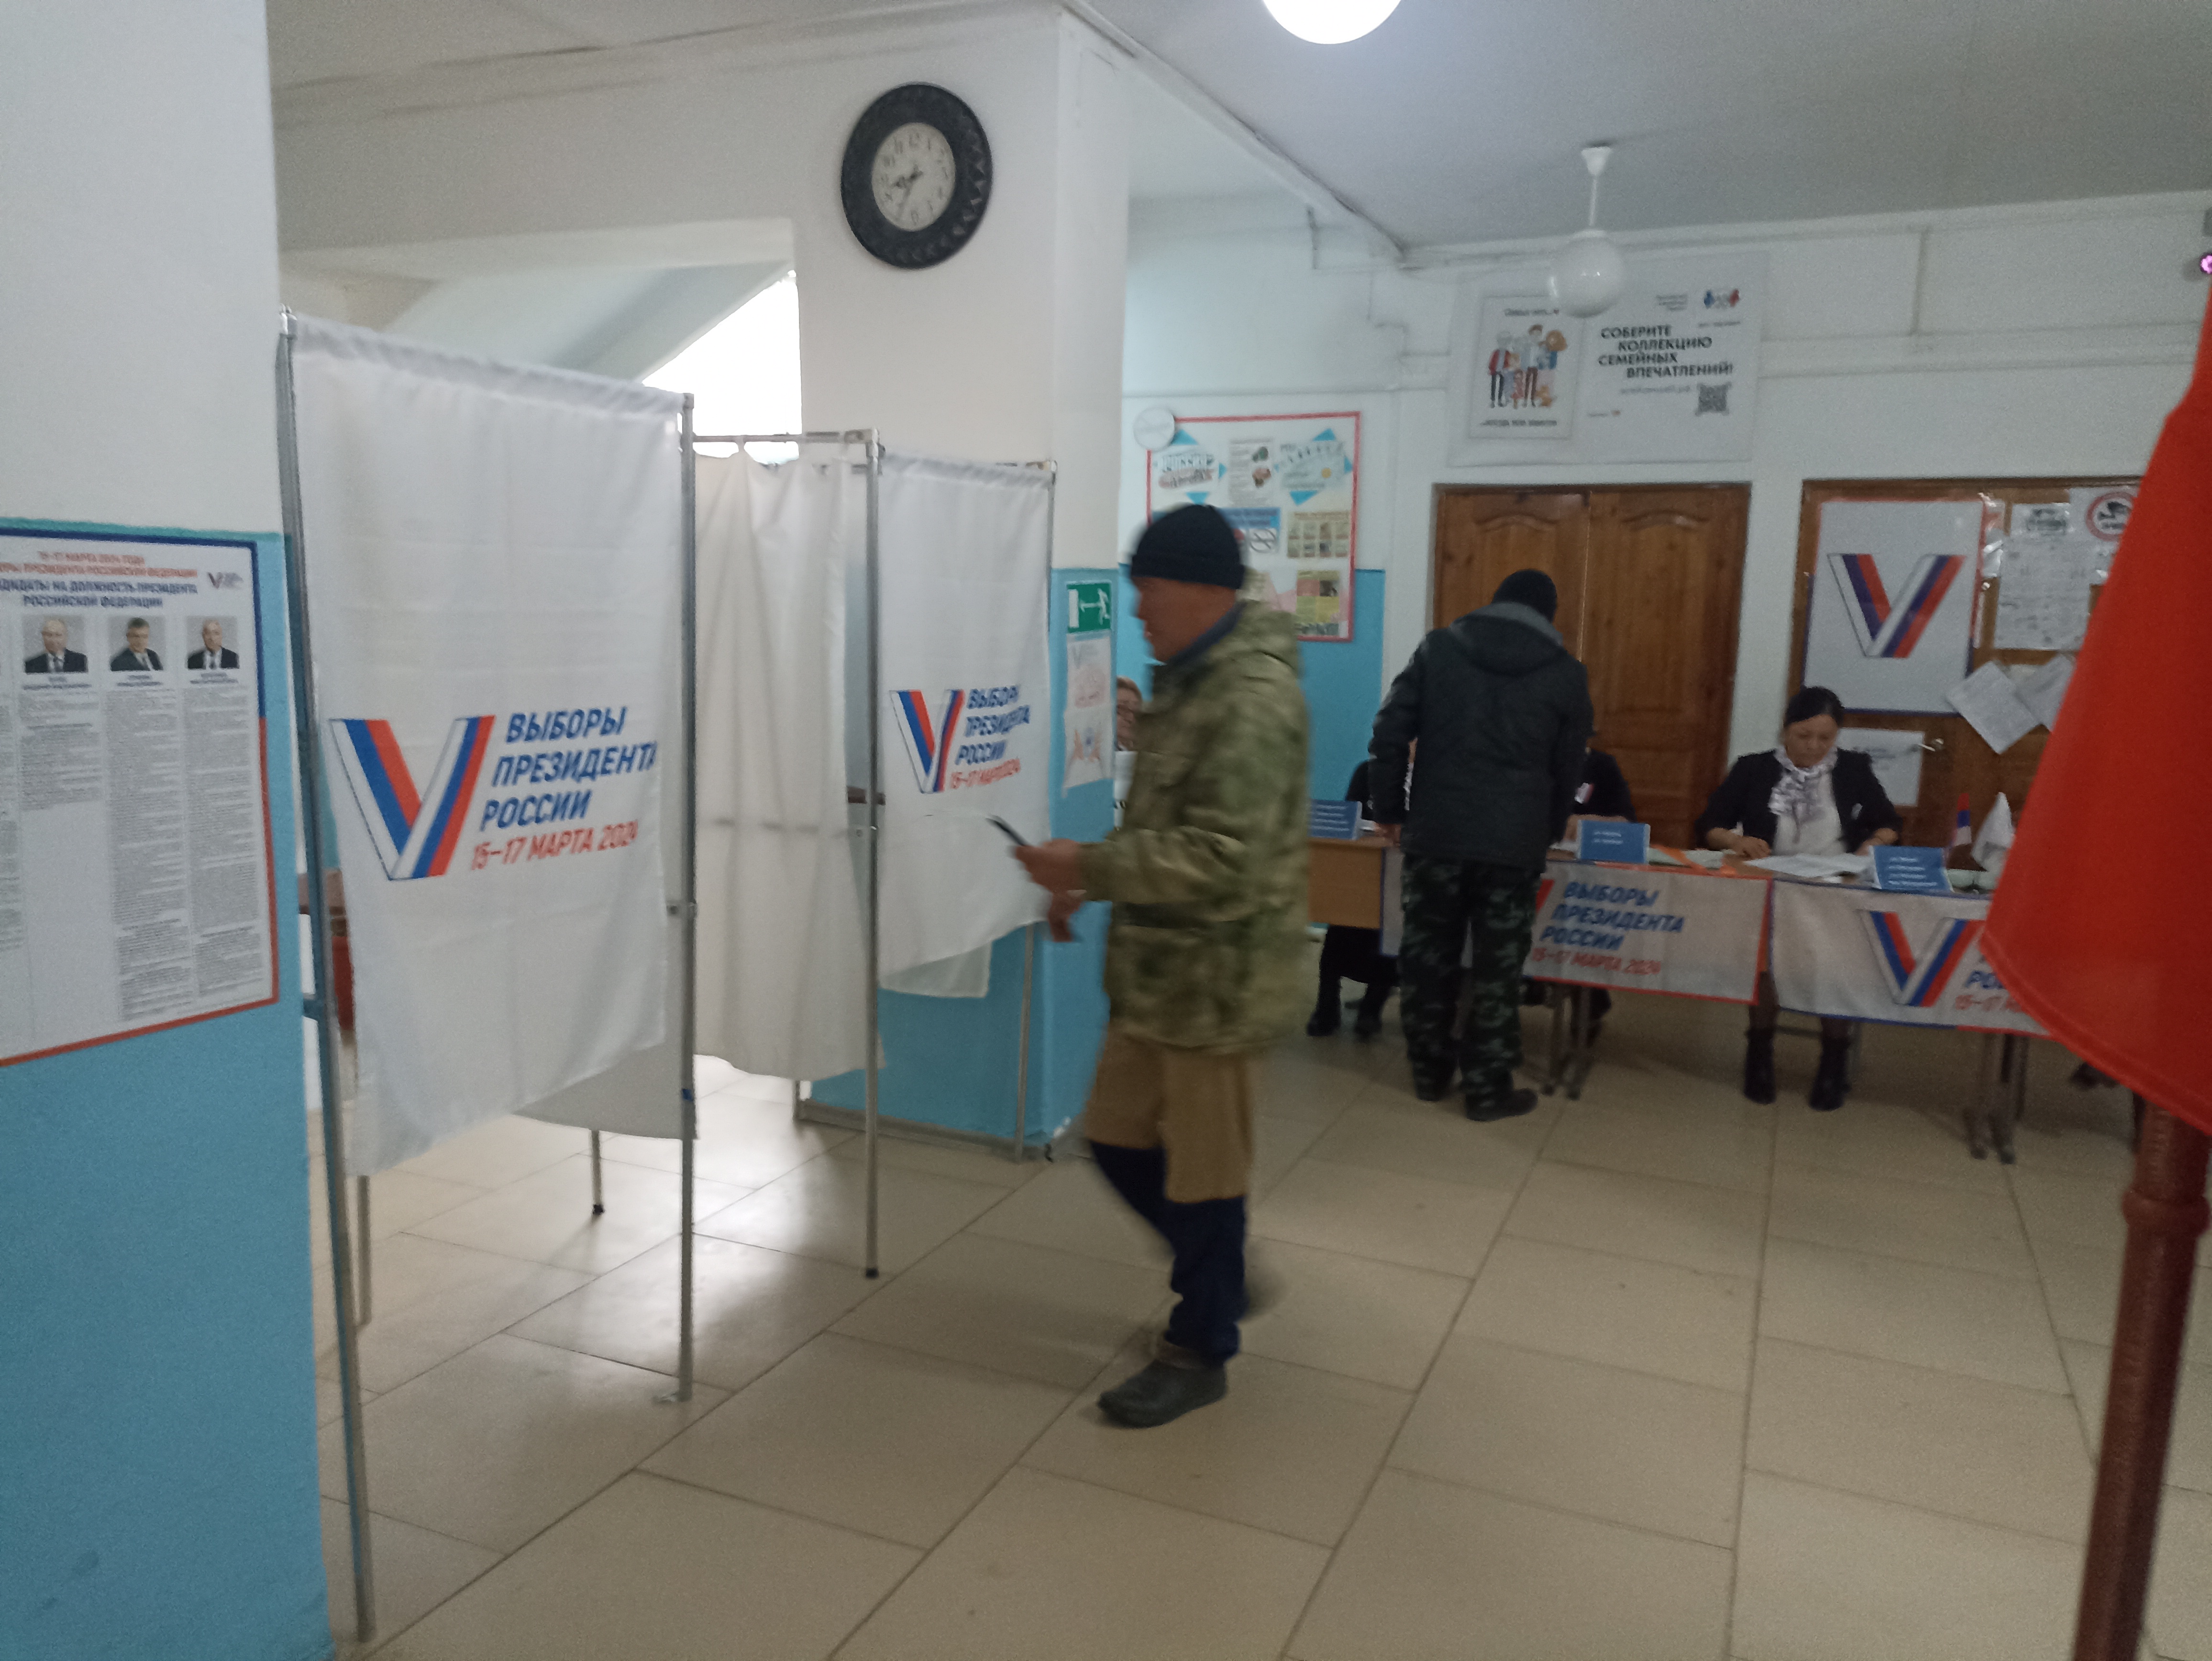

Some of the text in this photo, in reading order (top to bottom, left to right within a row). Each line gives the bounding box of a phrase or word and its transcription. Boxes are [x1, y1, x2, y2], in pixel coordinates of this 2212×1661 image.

[1601, 325, 1673, 339] СОБЕРИТЕ
[1618, 336, 1713, 352] КОЛЛЕКЦИЮ
[1598, 351, 1678, 366] СЕМЕЙНЫХ
[506, 706, 628, 744] ВЫБОРЫ
[479, 788, 594, 832] РОССИИ
[527, 827, 595, 861] МАРТА
[1564, 882, 1660, 907] ВЫБОРЫ
[1550, 903, 1685, 933] ПРЕЗИДЕНТА
[1539, 925, 1625, 951] РОССИИ
